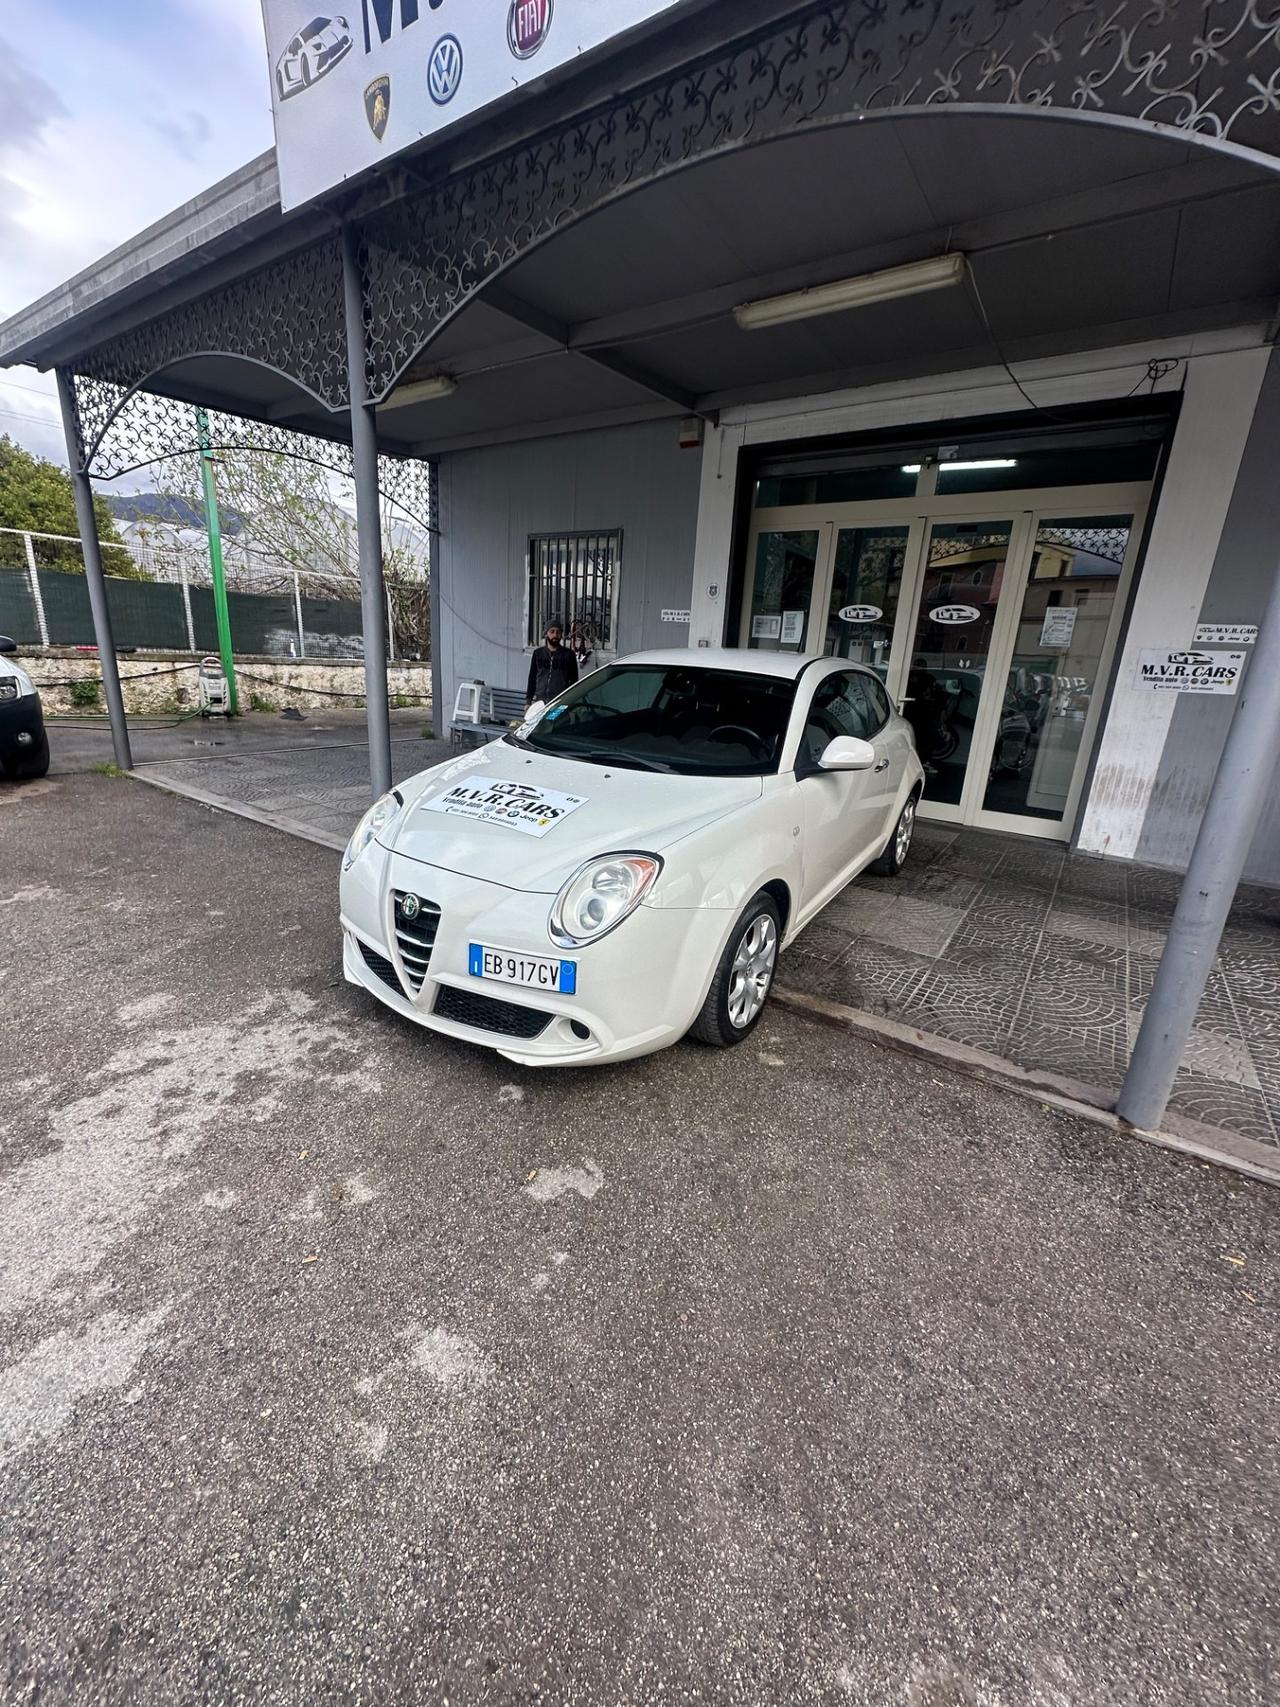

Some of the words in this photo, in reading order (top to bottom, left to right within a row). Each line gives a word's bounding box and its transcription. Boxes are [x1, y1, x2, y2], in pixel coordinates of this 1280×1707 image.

[518, 0, 542, 42] FIAT
[484, 953, 503, 975] EB
[507, 958, 559, 986] 917GV
